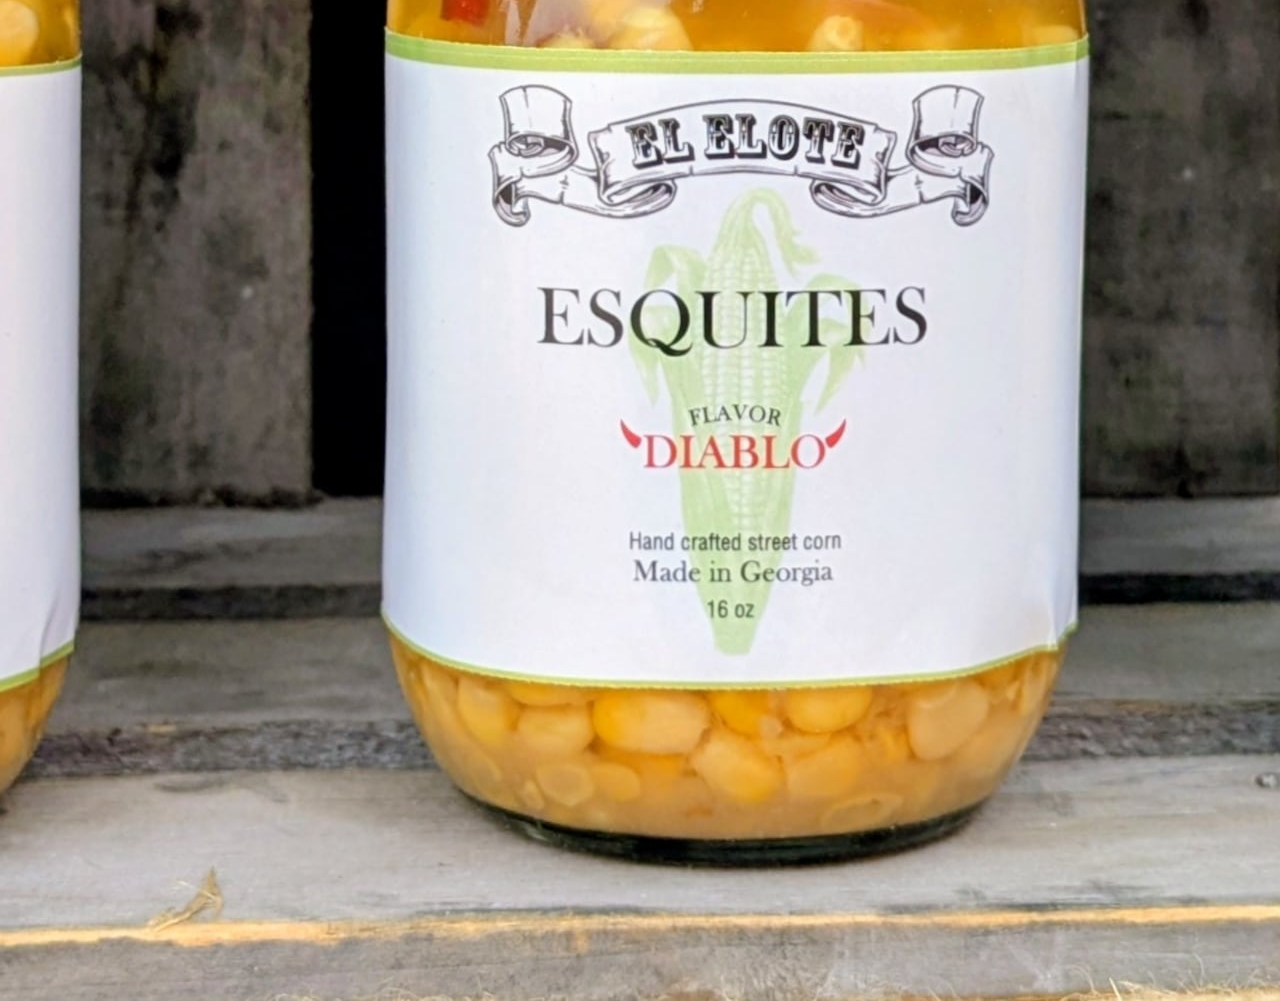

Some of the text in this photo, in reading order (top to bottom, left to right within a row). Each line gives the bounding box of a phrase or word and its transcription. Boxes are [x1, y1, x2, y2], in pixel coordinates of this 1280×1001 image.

[625, 112, 868, 170] EL ELOTE
[536, 285, 929, 359] ESQUITES
[688, 404, 782, 426] FLAVOR
[643, 434, 826, 469] DIABLO
[628, 531, 842, 552] Hand crafted street corn
[633, 558, 835, 588] Made in Georgia
[705, 599, 756, 620] 16 oz
